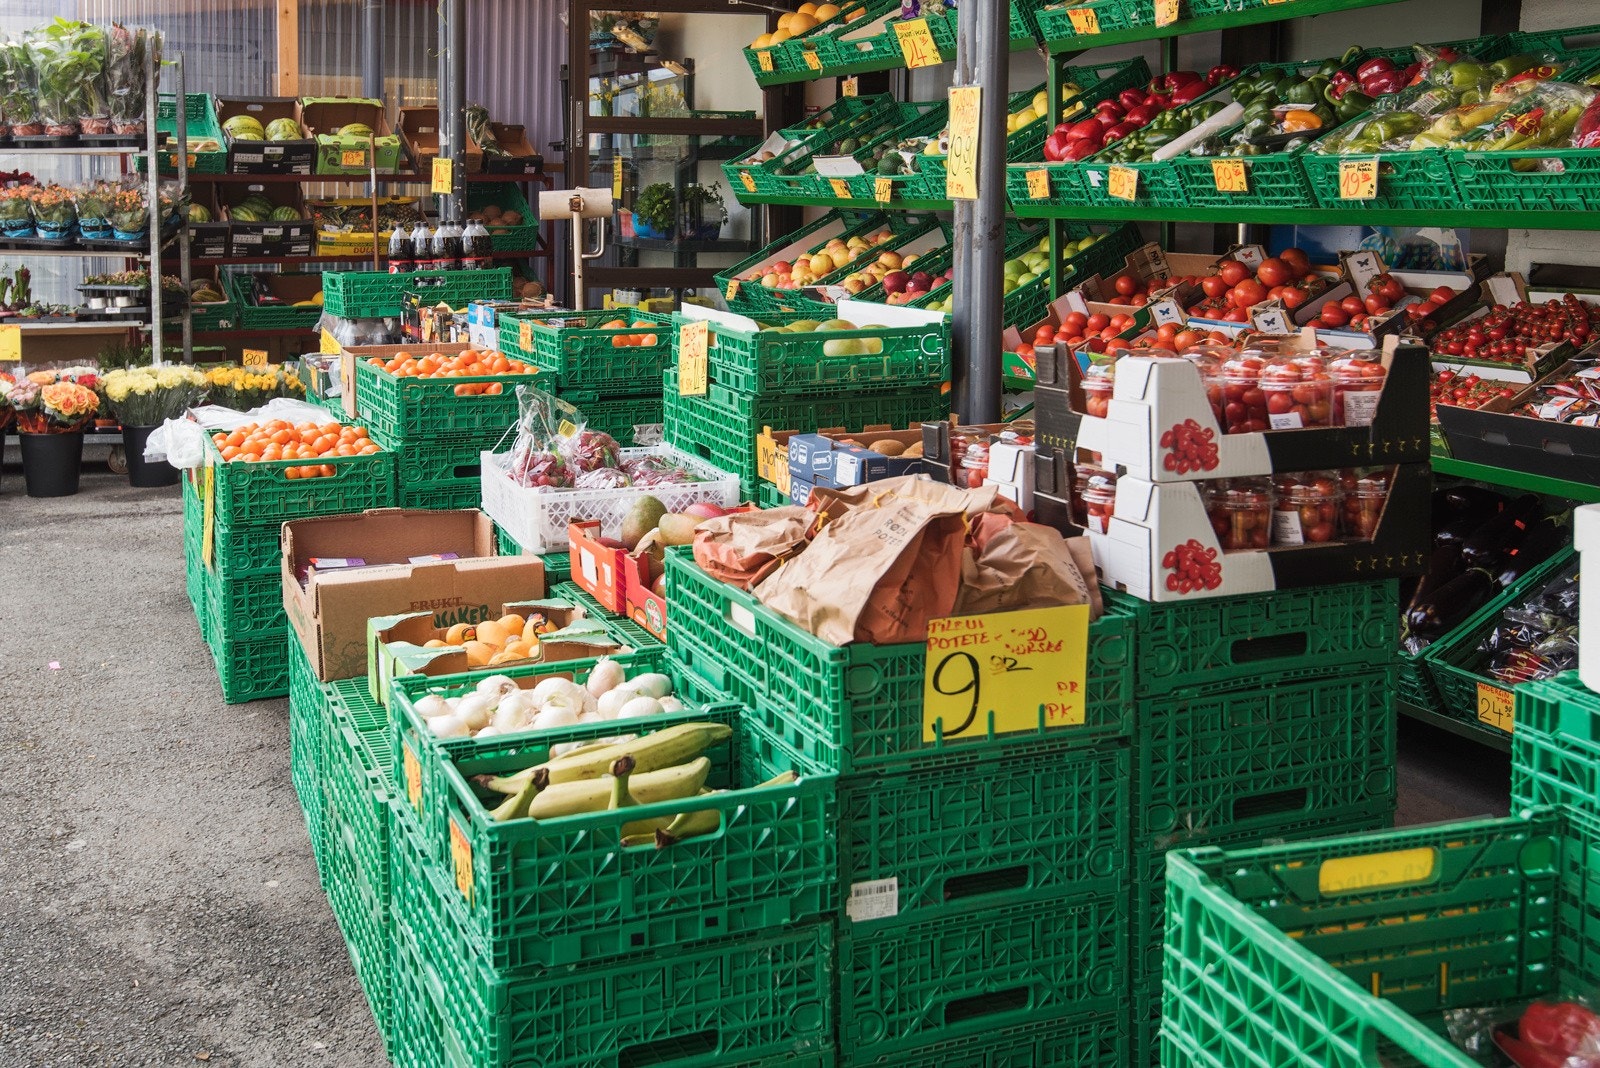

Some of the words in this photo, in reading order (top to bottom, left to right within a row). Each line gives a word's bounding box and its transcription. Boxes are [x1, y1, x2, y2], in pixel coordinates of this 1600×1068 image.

[903, 39, 928, 68] 24
[1110, 172, 1125, 194] 39
[1216, 165, 1233, 190] 69
[1342, 171, 1360, 197] 19
[875, 182, 887, 200] 49
[409, 596, 462, 611] FRUKT
[932, 651, 980, 737] 9
[1057, 681, 1079, 695] PR
[1480, 697, 1503, 726] 24
